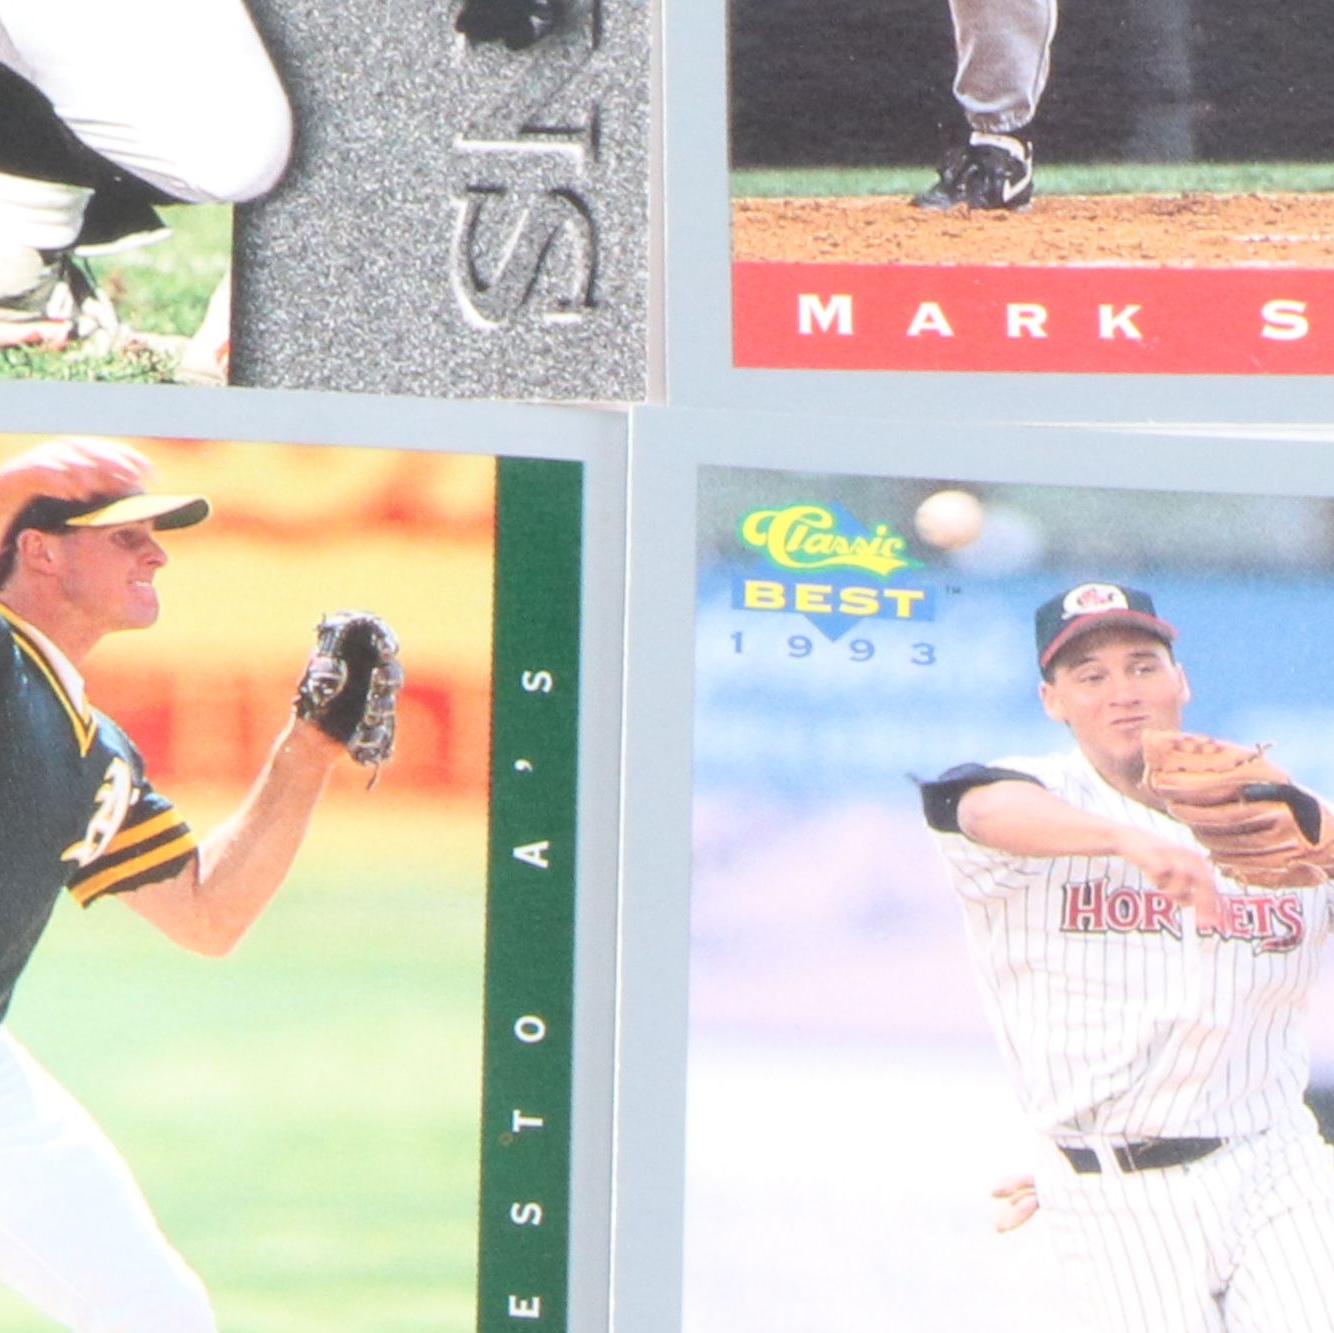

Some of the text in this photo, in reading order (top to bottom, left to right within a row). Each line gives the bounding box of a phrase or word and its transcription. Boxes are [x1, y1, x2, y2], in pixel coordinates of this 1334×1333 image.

[798, 294, 1143, 341] MARK
[742, 505, 909, 575] Classic
[743, 580, 925, 617] BEST
[730, 631, 938, 666] 1993
